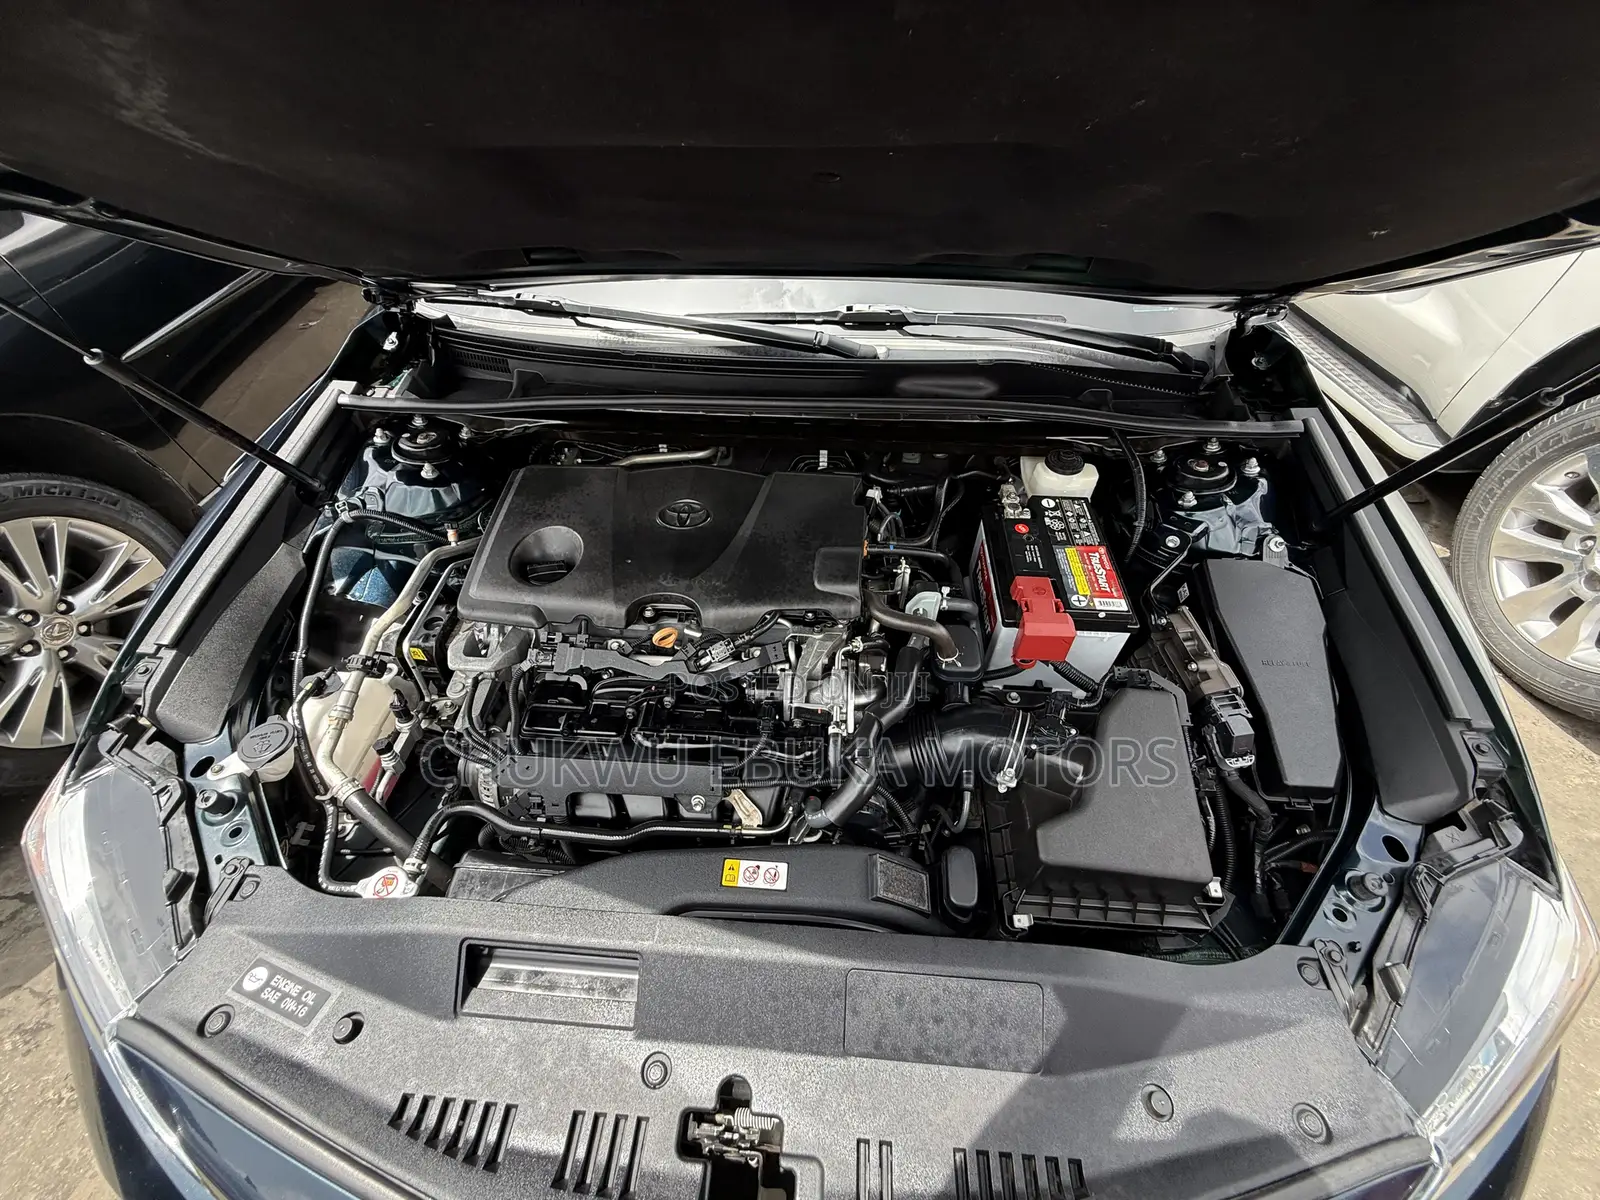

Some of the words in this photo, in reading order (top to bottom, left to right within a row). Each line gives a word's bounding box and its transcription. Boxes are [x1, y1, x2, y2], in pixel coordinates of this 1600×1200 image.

[12, 484, 120, 509] MICHELIN
[260, 986, 283, 1005] SAE
[279, 996, 309, 1018] 0W-16
[269, 973, 303, 998] ENGINE
[300, 989, 318, 1006] OIL
